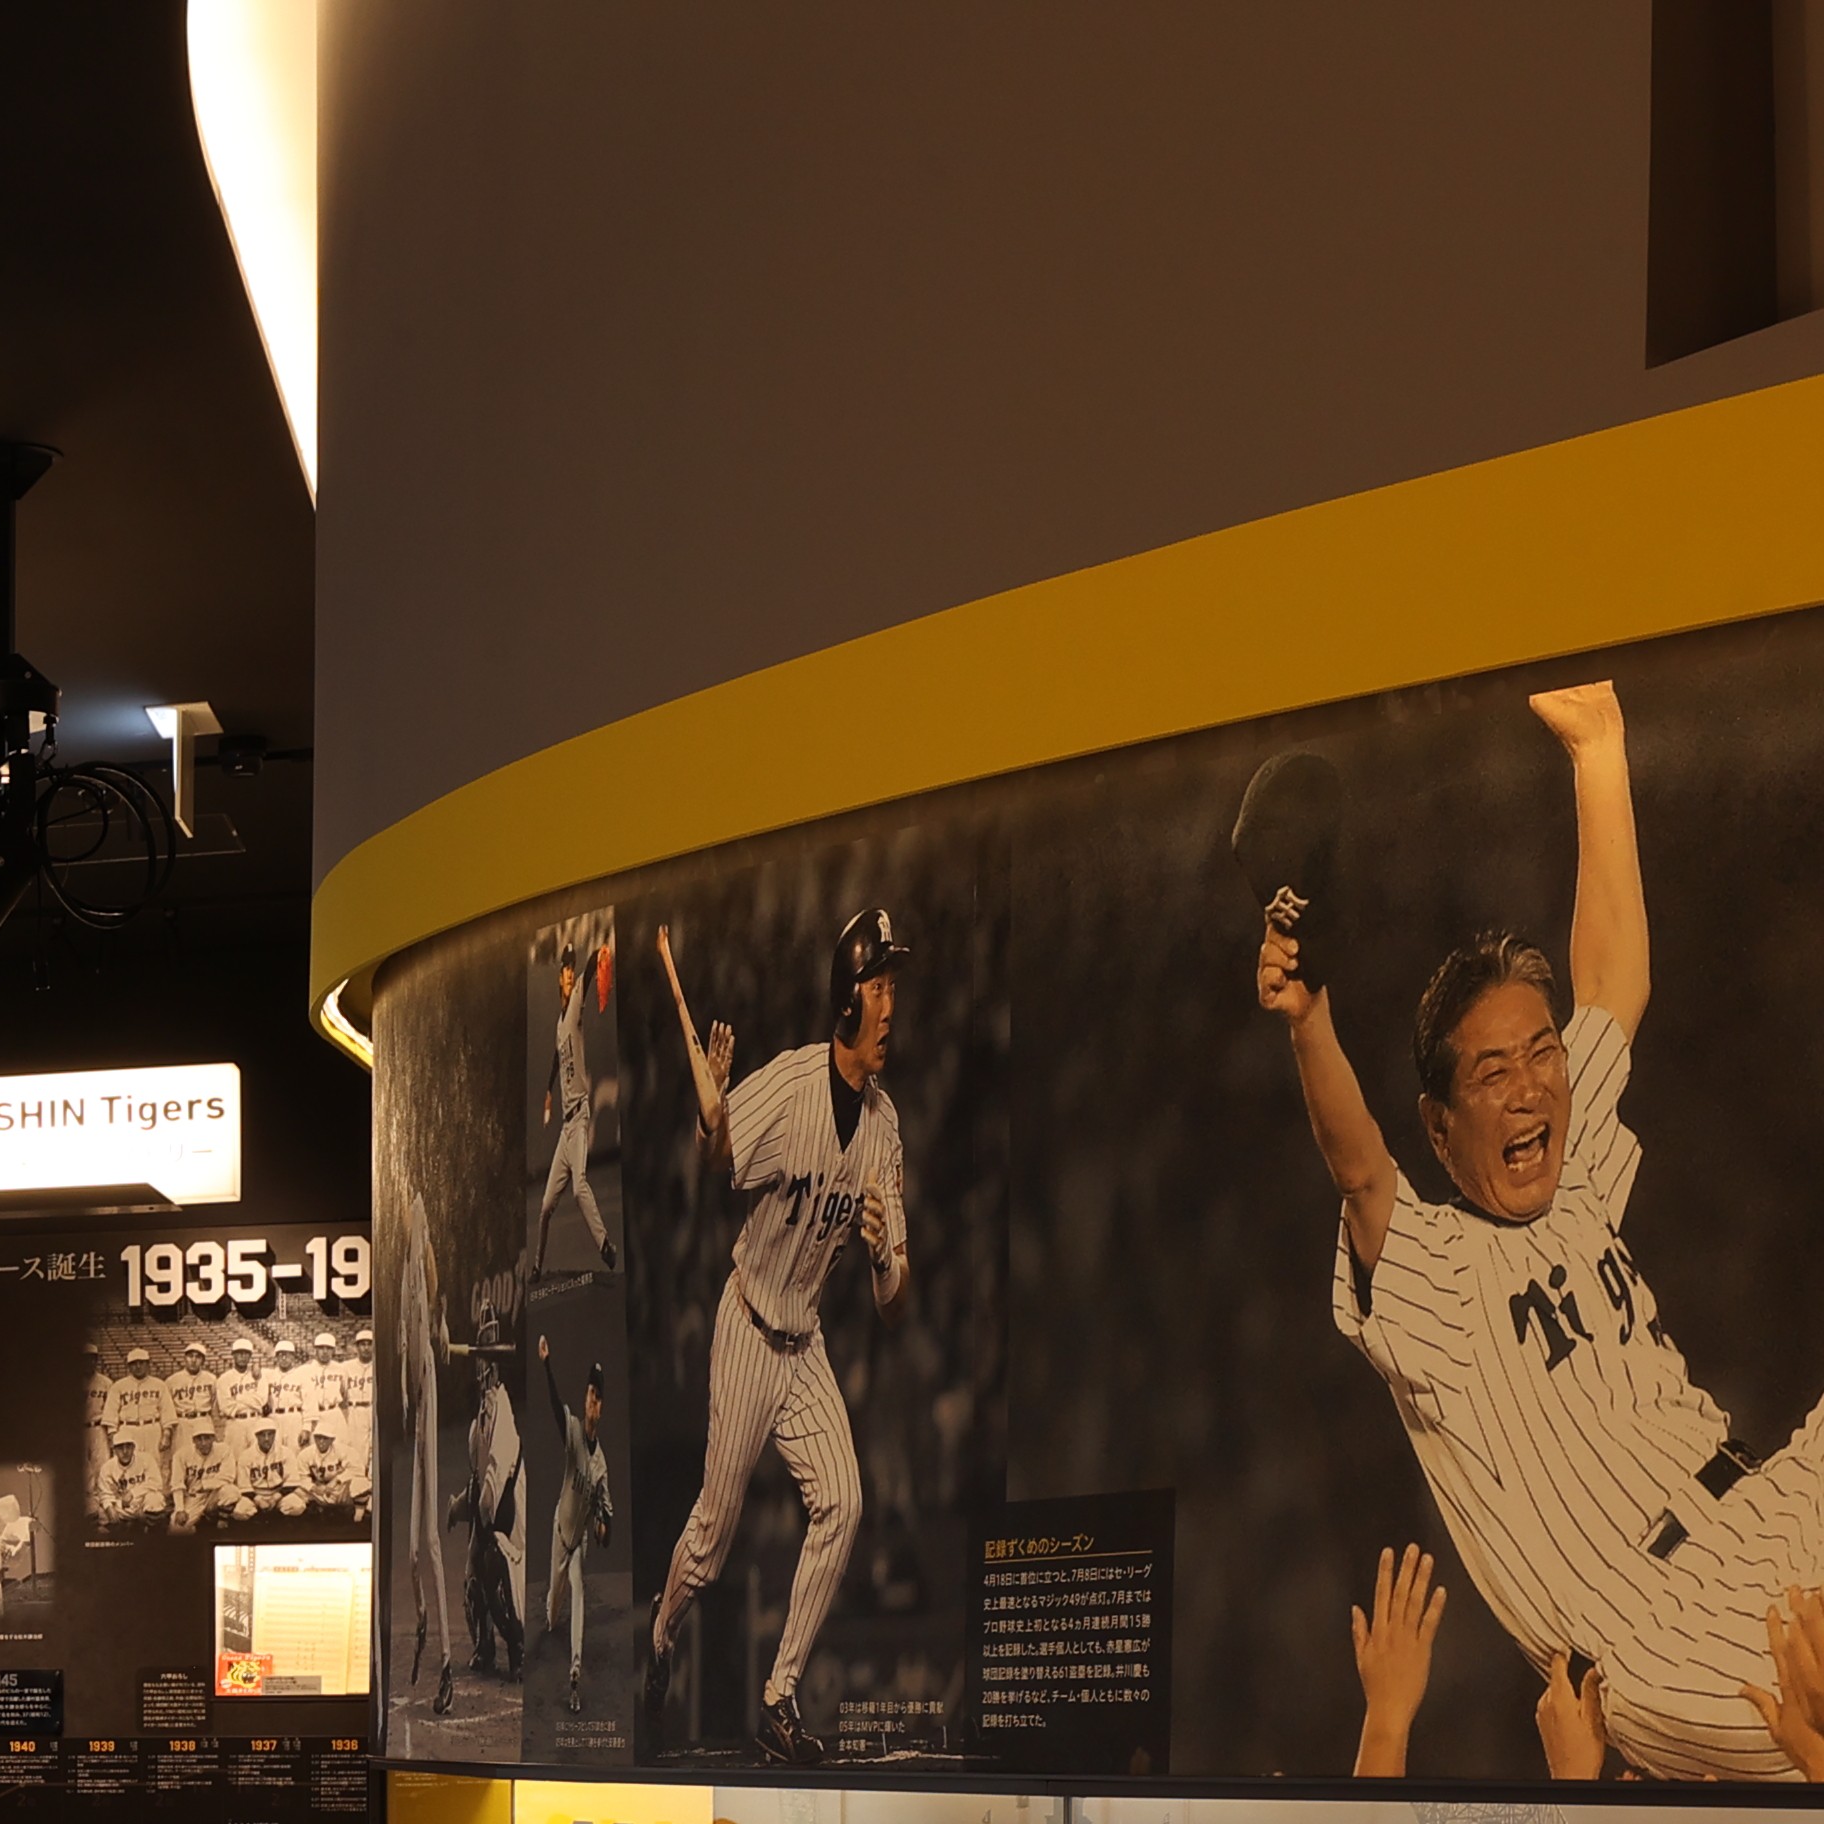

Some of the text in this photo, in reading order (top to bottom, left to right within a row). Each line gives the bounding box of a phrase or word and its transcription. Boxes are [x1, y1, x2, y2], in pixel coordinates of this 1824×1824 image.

[100, 1093, 226, 1131] Tigers
[9, 1741, 36, 1752] 1940
[89, 1740, 115, 1752] 1939
[169, 1740, 195, 1751] 1938
[250, 1740, 277, 1751] 1937
